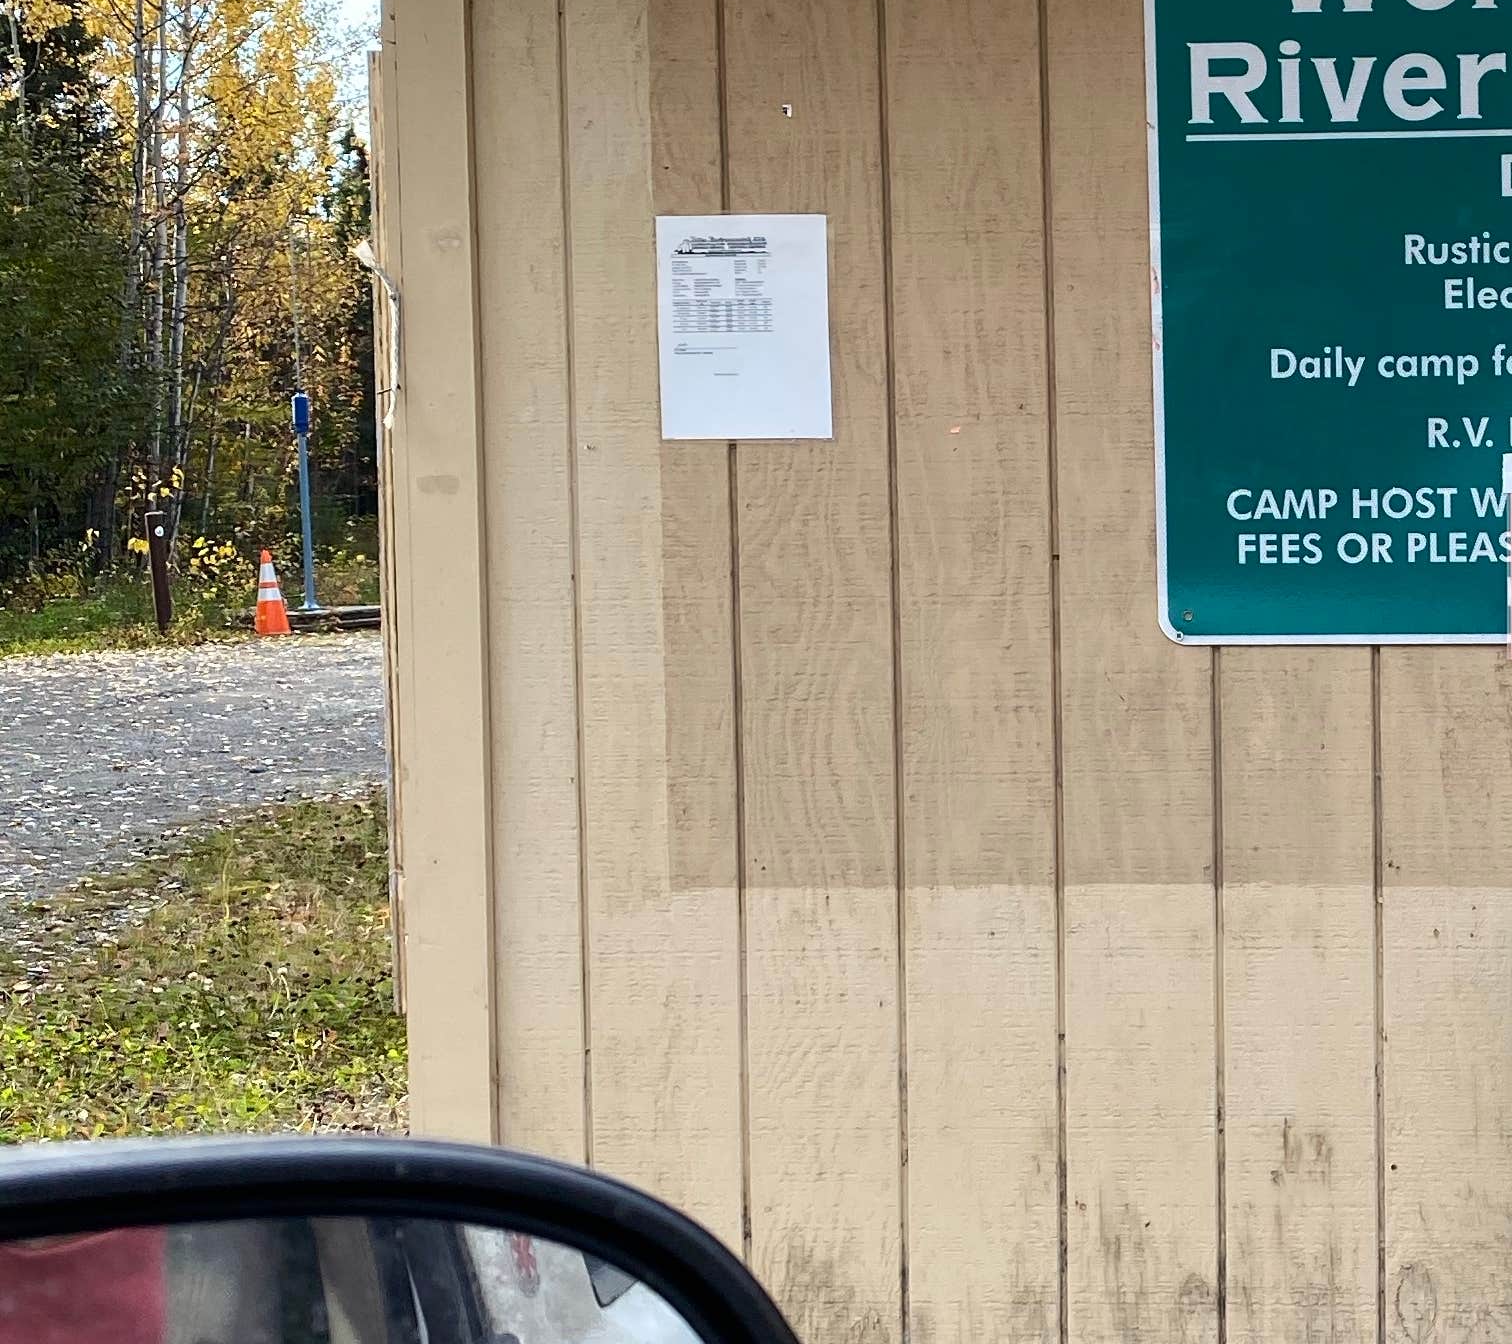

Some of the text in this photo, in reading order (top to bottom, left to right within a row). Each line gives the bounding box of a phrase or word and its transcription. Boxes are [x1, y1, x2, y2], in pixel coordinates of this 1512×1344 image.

[1404, 232, 1510, 265] Rustic
[1270, 346, 1366, 386] Daily
[1377, 352, 1479, 385] camp
[1427, 417, 1494, 448] R.V.
[1226, 488, 1338, 520] CAMP
[1352, 487, 1458, 519] HOST
[1238, 533, 1323, 564] FEES
[1336, 532, 1393, 563] OR
[1407, 531, 1511, 563] PLEAS
